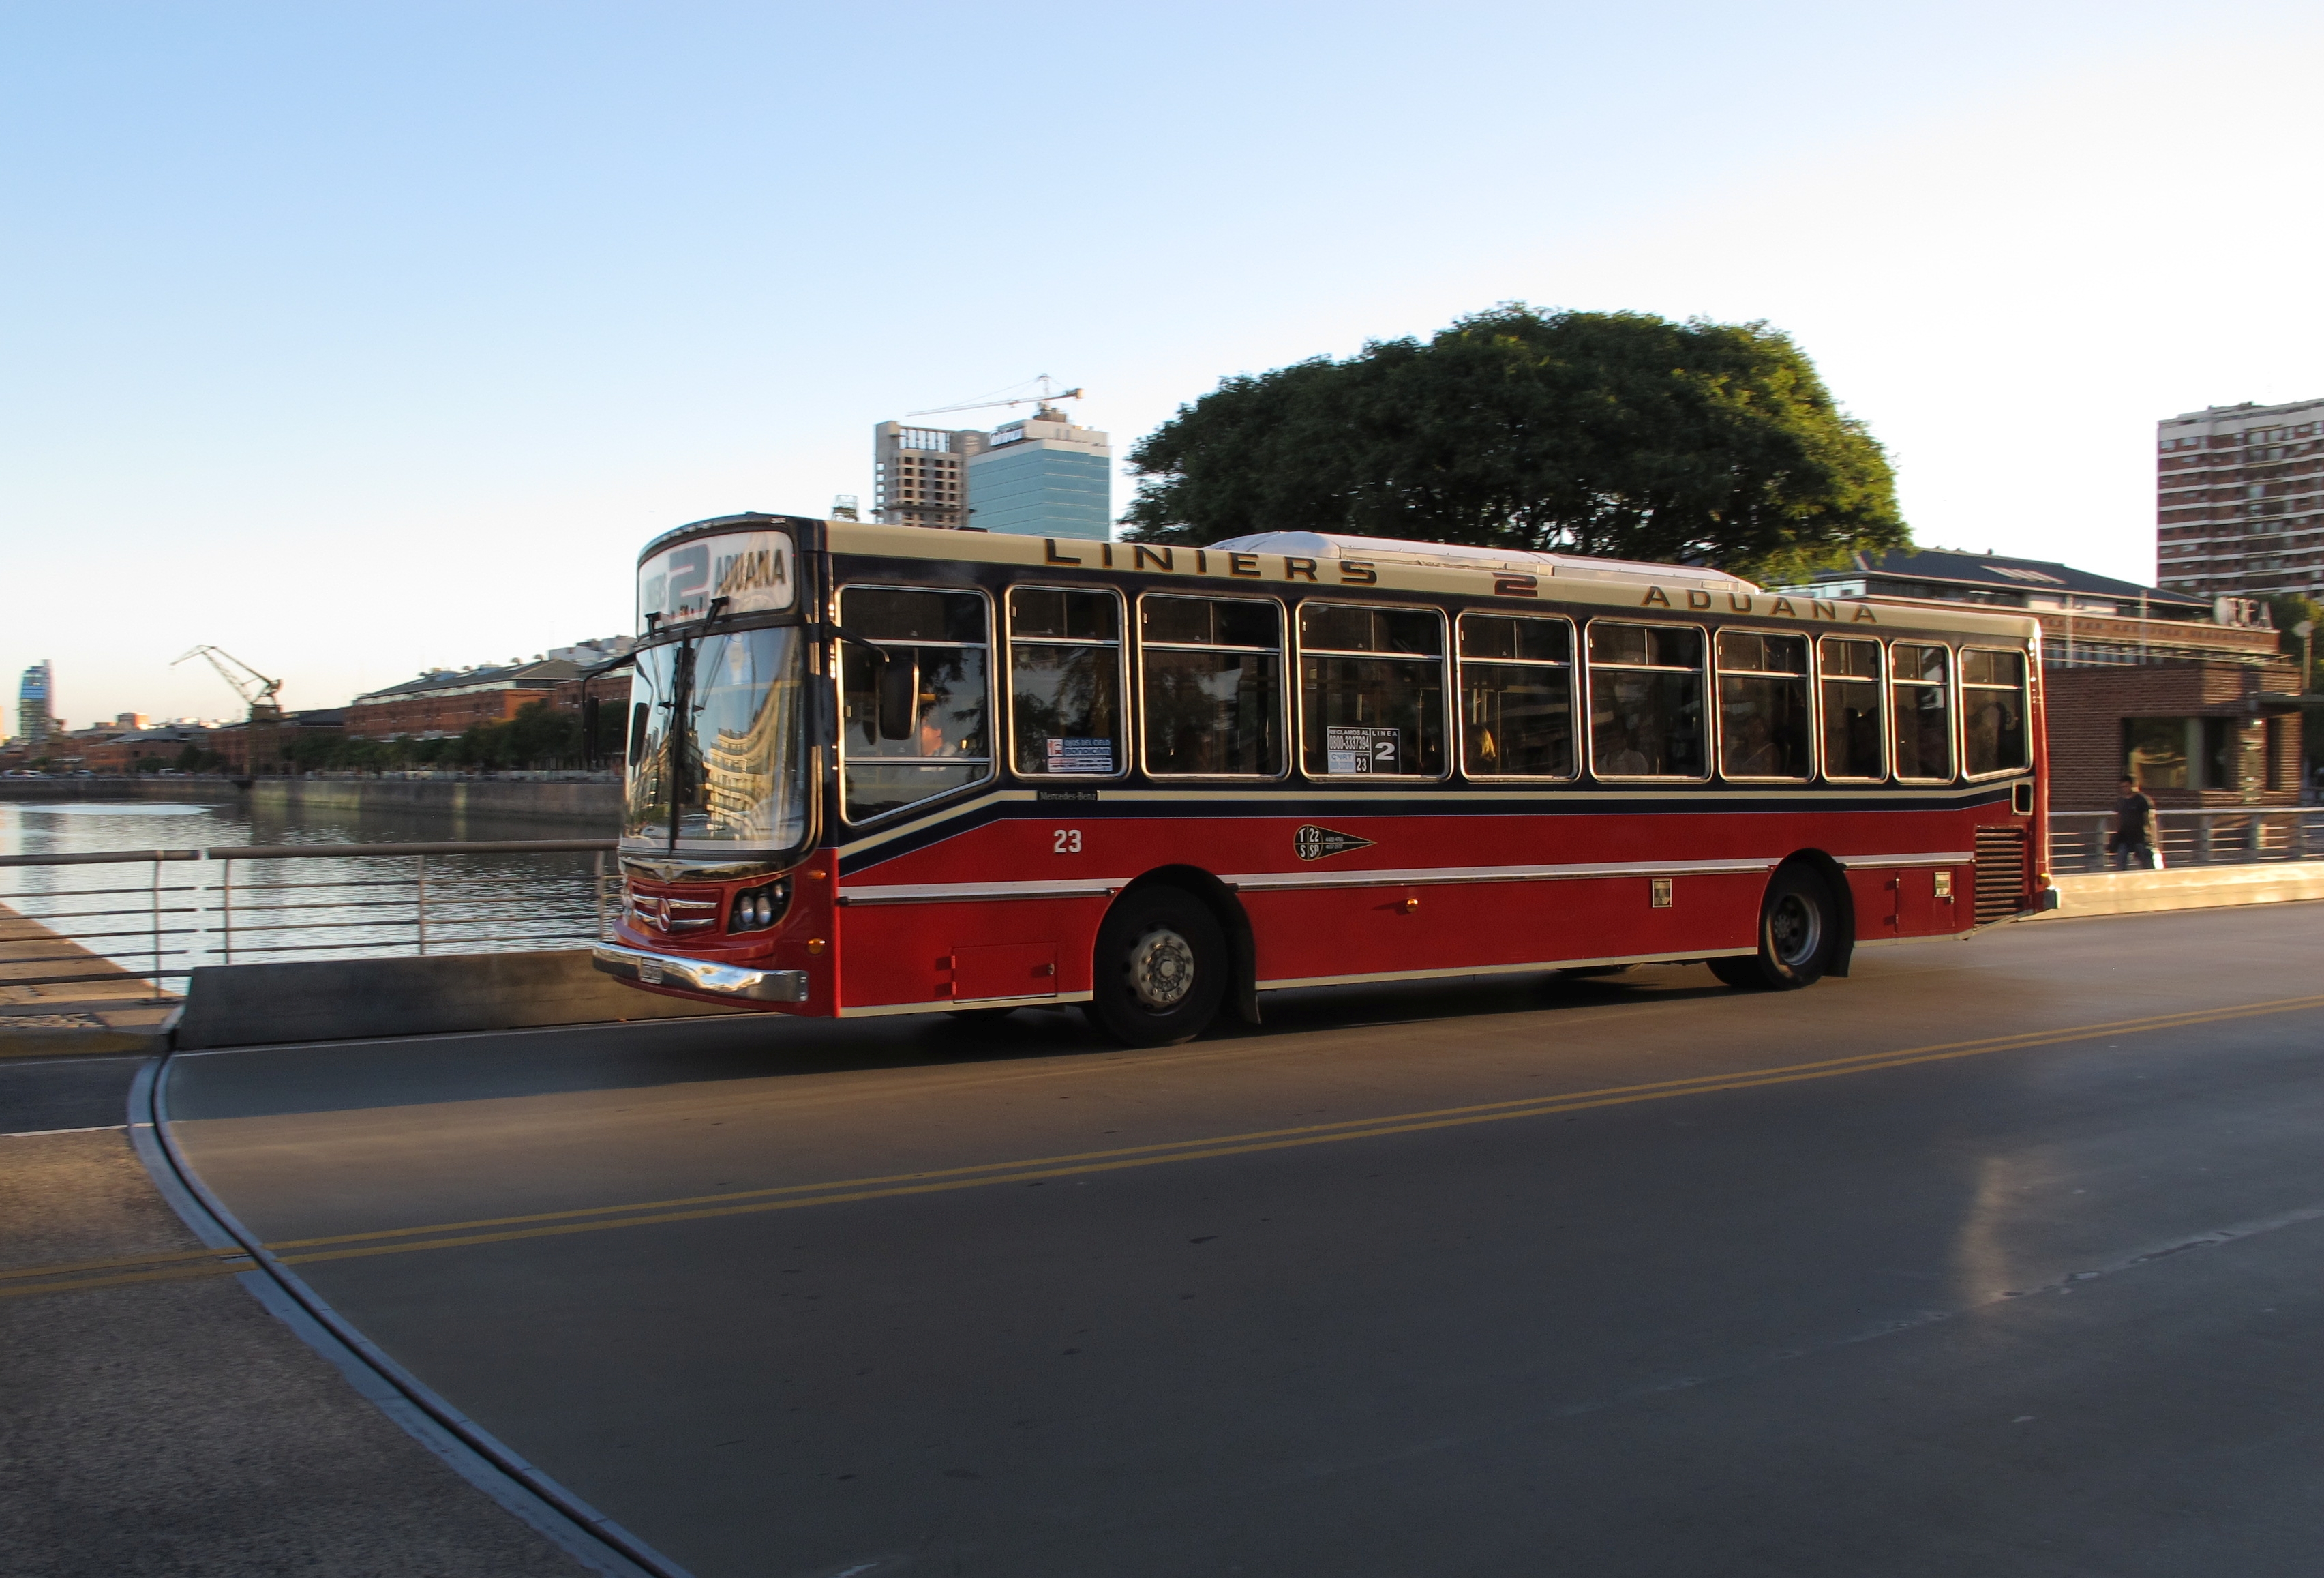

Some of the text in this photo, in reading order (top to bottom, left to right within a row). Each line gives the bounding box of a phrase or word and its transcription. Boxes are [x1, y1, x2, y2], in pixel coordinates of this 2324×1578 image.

[669, 544, 710, 618] 2
[714, 550, 786, 595] ADUANA
[1044, 538, 1878, 623] LINIERS 2 ADUANA
[1374, 742, 1395, 760] 2
[1356, 758, 1367, 771] 23
[1040, 791, 1096, 801] Mercedes-Benz
[1053, 829, 1083, 854] 23
[1298, 827, 1320, 842] T 22
[1300, 844, 1306, 858] S
